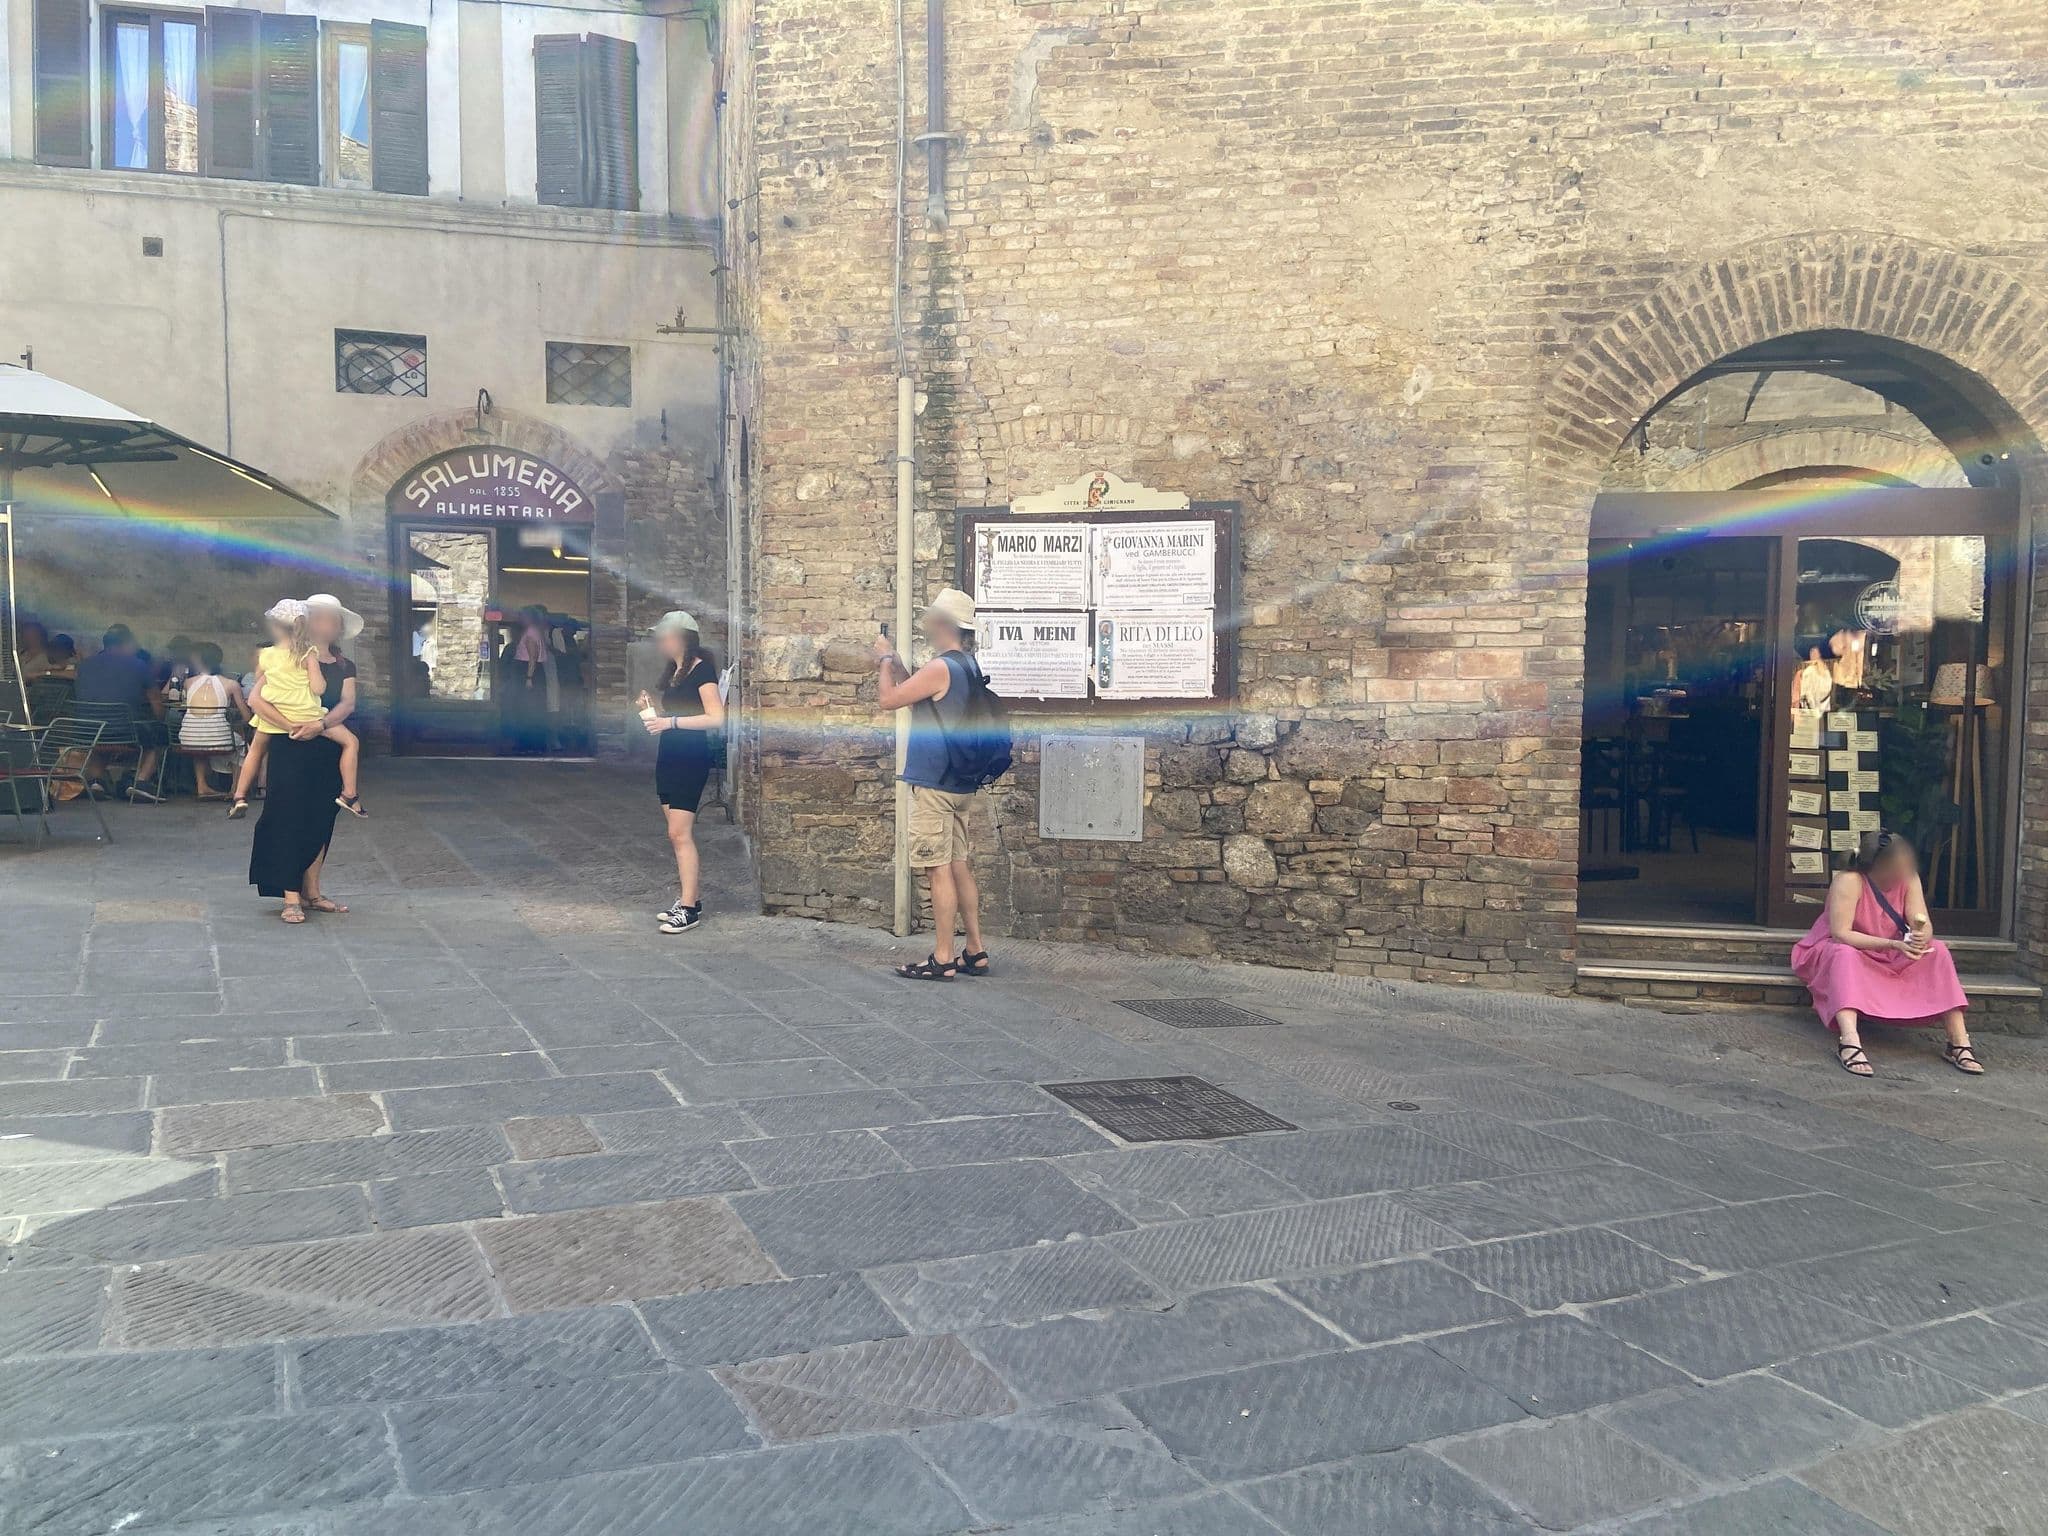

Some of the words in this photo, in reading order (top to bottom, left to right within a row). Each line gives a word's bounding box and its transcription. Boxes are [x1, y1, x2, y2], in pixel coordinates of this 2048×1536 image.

[405, 371, 418, 380] LG
[404, 453, 583, 514] SALUMERIA
[469, 488, 487, 496] DAL
[493, 486, 521, 498] 1855
[436, 501, 552, 518] ALIMENTARI
[997, 535, 1037, 553] MARIO
[1043, 535, 1082, 553] MARZI
[1113, 535, 1165, 549] GIOVANNA
[1167, 534, 1204, 548] MARINI
[1143, 548, 1196, 558] GAMBERUCCI
[999, 626, 1023, 641] IVA
[1033, 626, 1076, 641] MEINI
[1120, 626, 1152, 641] RITA
[1156, 626, 1171, 641] DI
[1175, 626, 1203, 641] LEO
